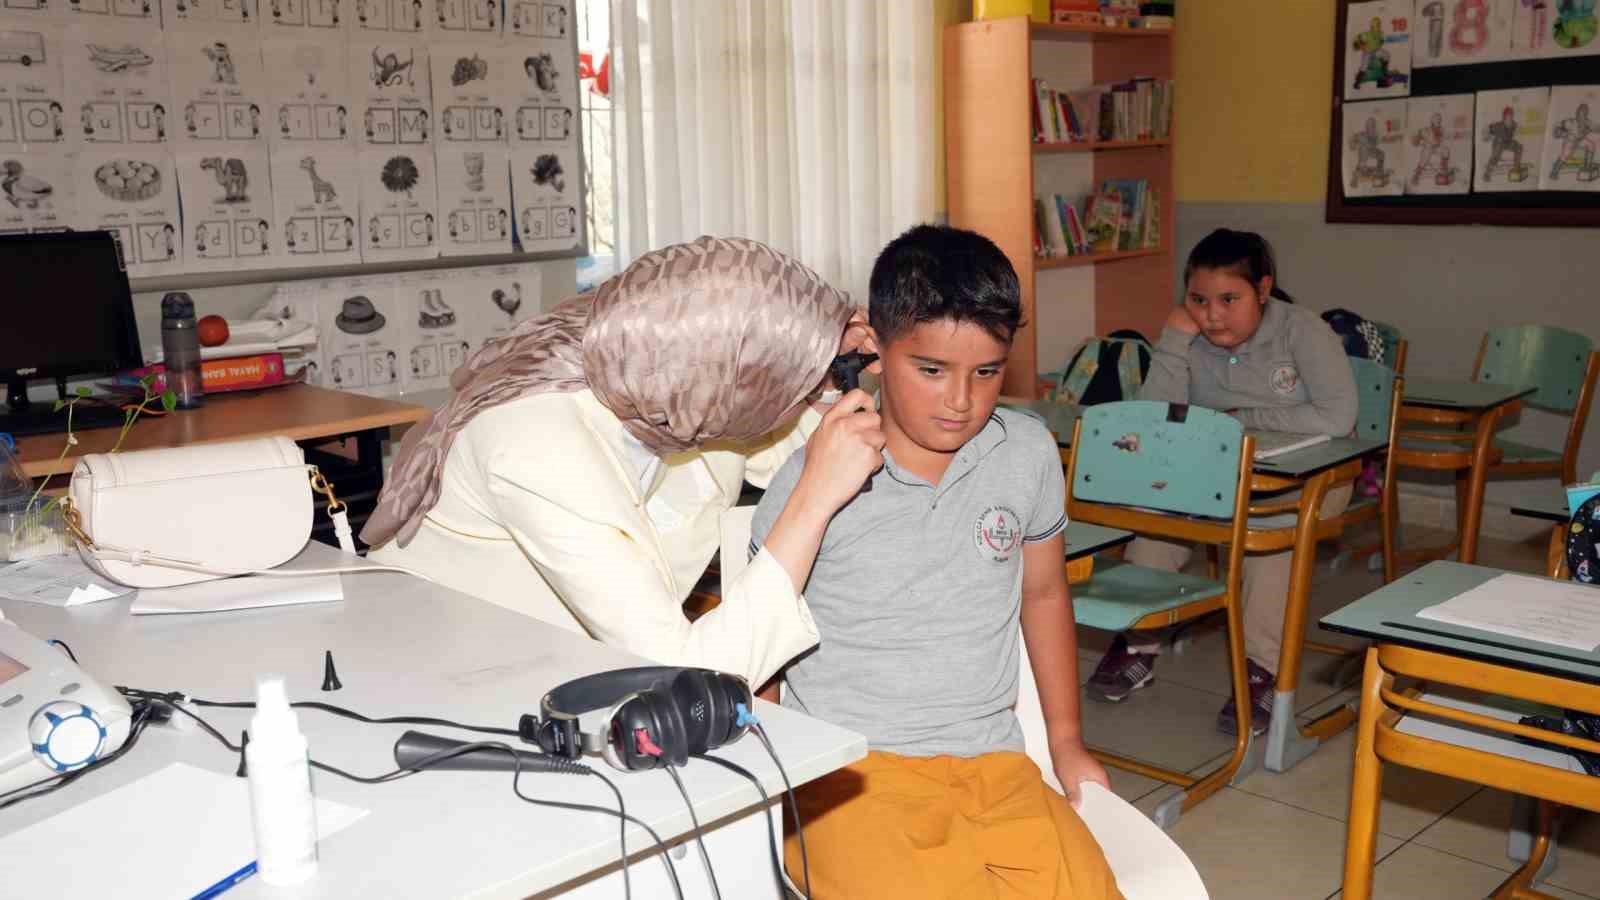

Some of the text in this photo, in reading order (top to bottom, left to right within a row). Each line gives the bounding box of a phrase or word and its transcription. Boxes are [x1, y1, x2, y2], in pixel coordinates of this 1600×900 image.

[28, 108, 49, 128] O
[101, 111, 150, 129] u U
[203, 109, 246, 128] r R
[377, 116, 419, 133] m M
[550, 113, 560, 128] S
[327, 222, 341, 241] Z
[461, 214, 497, 232] b B
[145, 231, 160, 249] Y
[212, 225, 256, 246] d D
[422, 358, 432, 372] p
